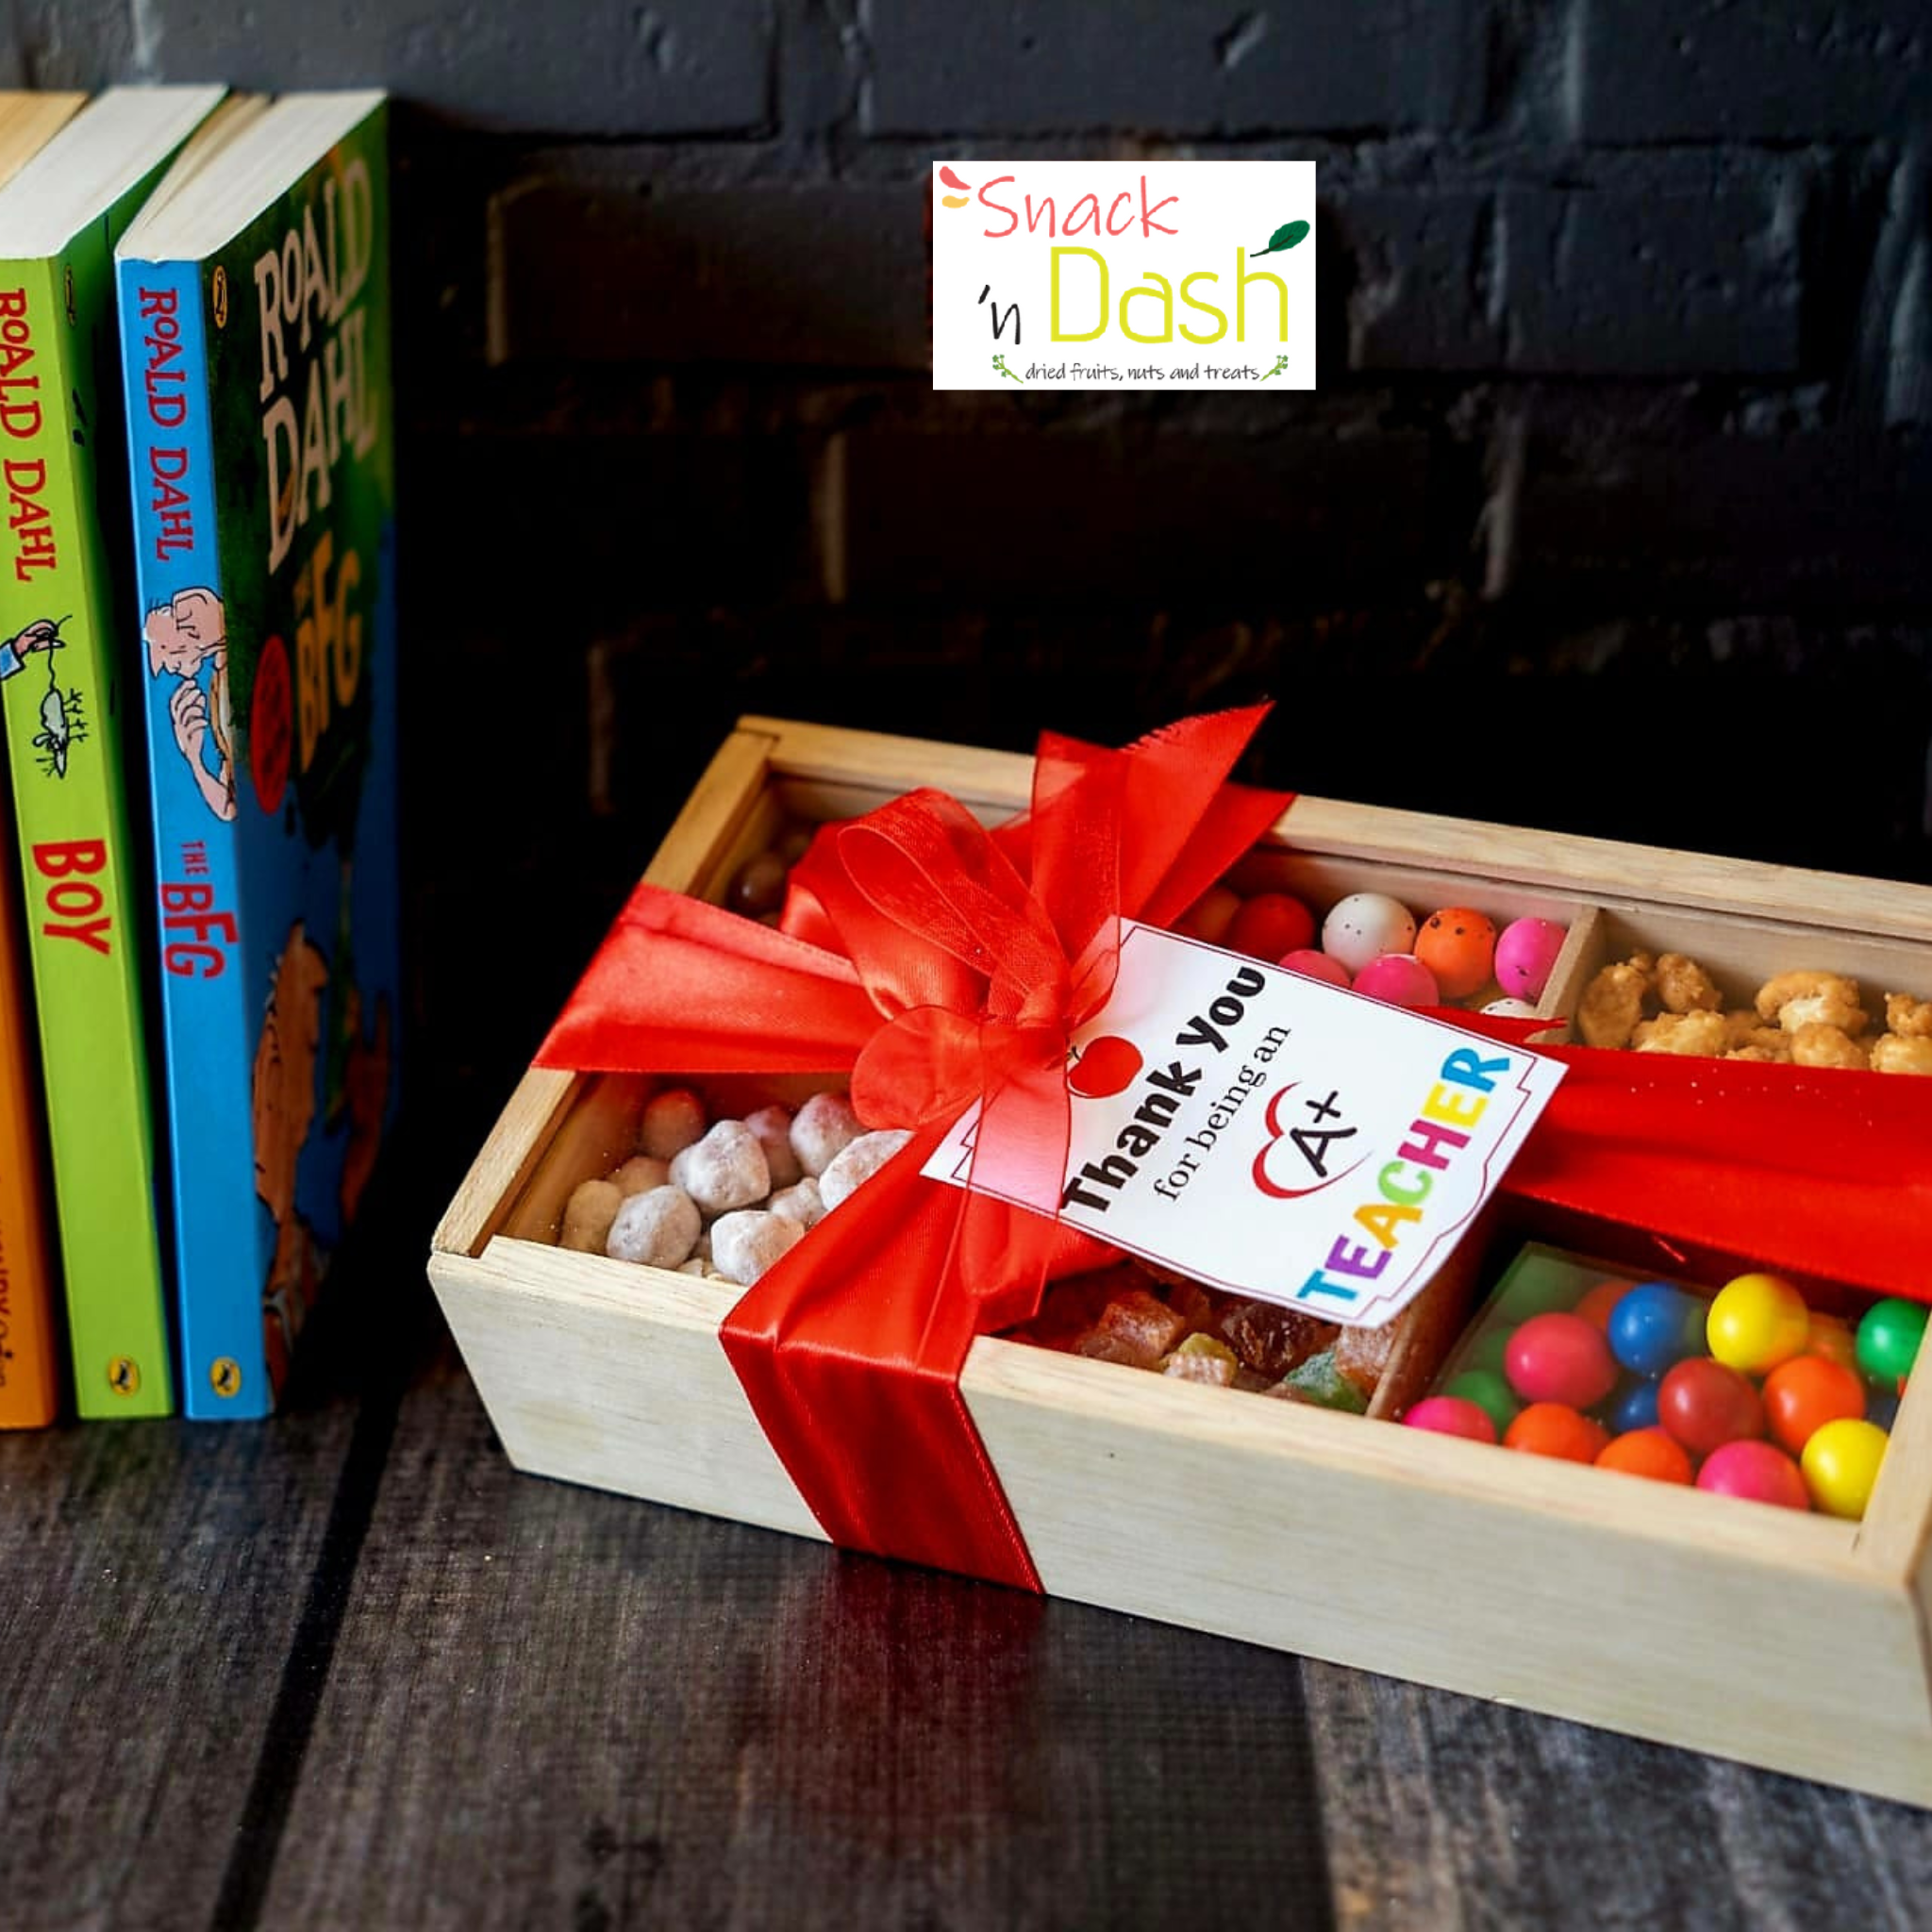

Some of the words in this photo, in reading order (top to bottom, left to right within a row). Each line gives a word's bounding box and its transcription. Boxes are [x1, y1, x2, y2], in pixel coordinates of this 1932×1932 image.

[255, 158, 374, 404] ROALD
[0, 288, 43, 439] ROALD
[139, 287, 189, 428] ROALD
[149, 446, 193, 561] DAHL
[262, 307, 377, 575] DAHL
[4, 458, 57, 582] DAHL
[296, 530, 362, 774] BFG
[31, 839, 111, 957] BOY
[181, 841, 209, 874] THE
[160, 883, 240, 979] BFG
[1059, 1061, 1202, 1212] Thank
[1153, 1153, 1202, 1203] for
[1185, 1065, 1267, 1151] being
[1254, 1025, 1291, 1062] an
[1290, 1091, 1357, 1178] A+
[1296, 1048, 1510, 1301] TEACHER
